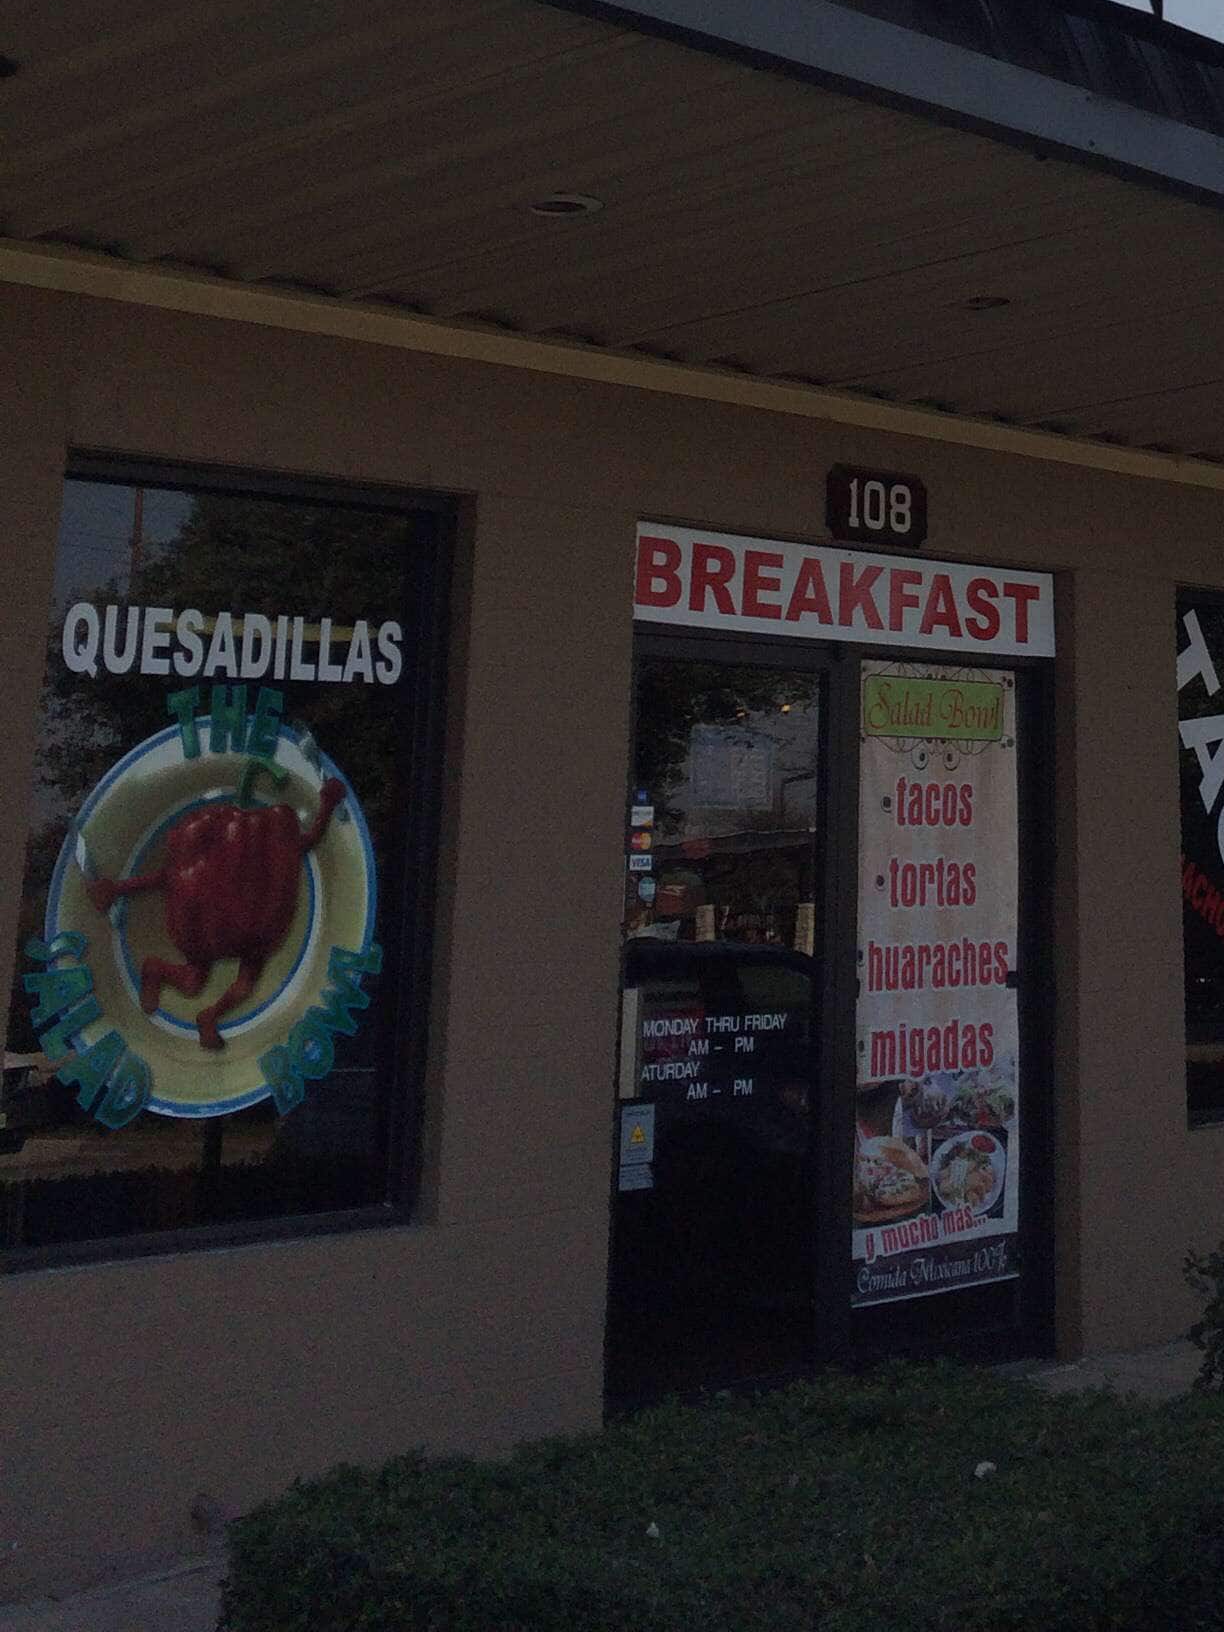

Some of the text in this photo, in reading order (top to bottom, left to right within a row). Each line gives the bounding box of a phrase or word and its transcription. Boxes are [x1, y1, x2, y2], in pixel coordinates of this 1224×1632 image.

[847, 479, 913, 533] 108
[635, 535, 1040, 645] BREAKFAST
[62, 601, 402, 685] QUESADILLAS
[167, 684, 284, 759] THE
[868, 681, 1001, 730] Salad Bowl
[896, 776, 974, 827] tacos
[631, 856, 650, 869] VISA
[889, 857, 977, 907] tortas
[868, 940, 1009, 993] huaraches
[24, 931, 383, 1130] SALAD BOWL
[643, 1013, 788, 1038] MONDAY THRU FRIDAY
[688, 1039, 709, 1056] AM
[734, 1037, 754, 1054] PM
[870, 1019, 994, 1078] migadas
[686, 1083, 708, 1100] AM
[733, 1079, 753, 1096] PM
[881, 1215, 940, 1254] mucho
